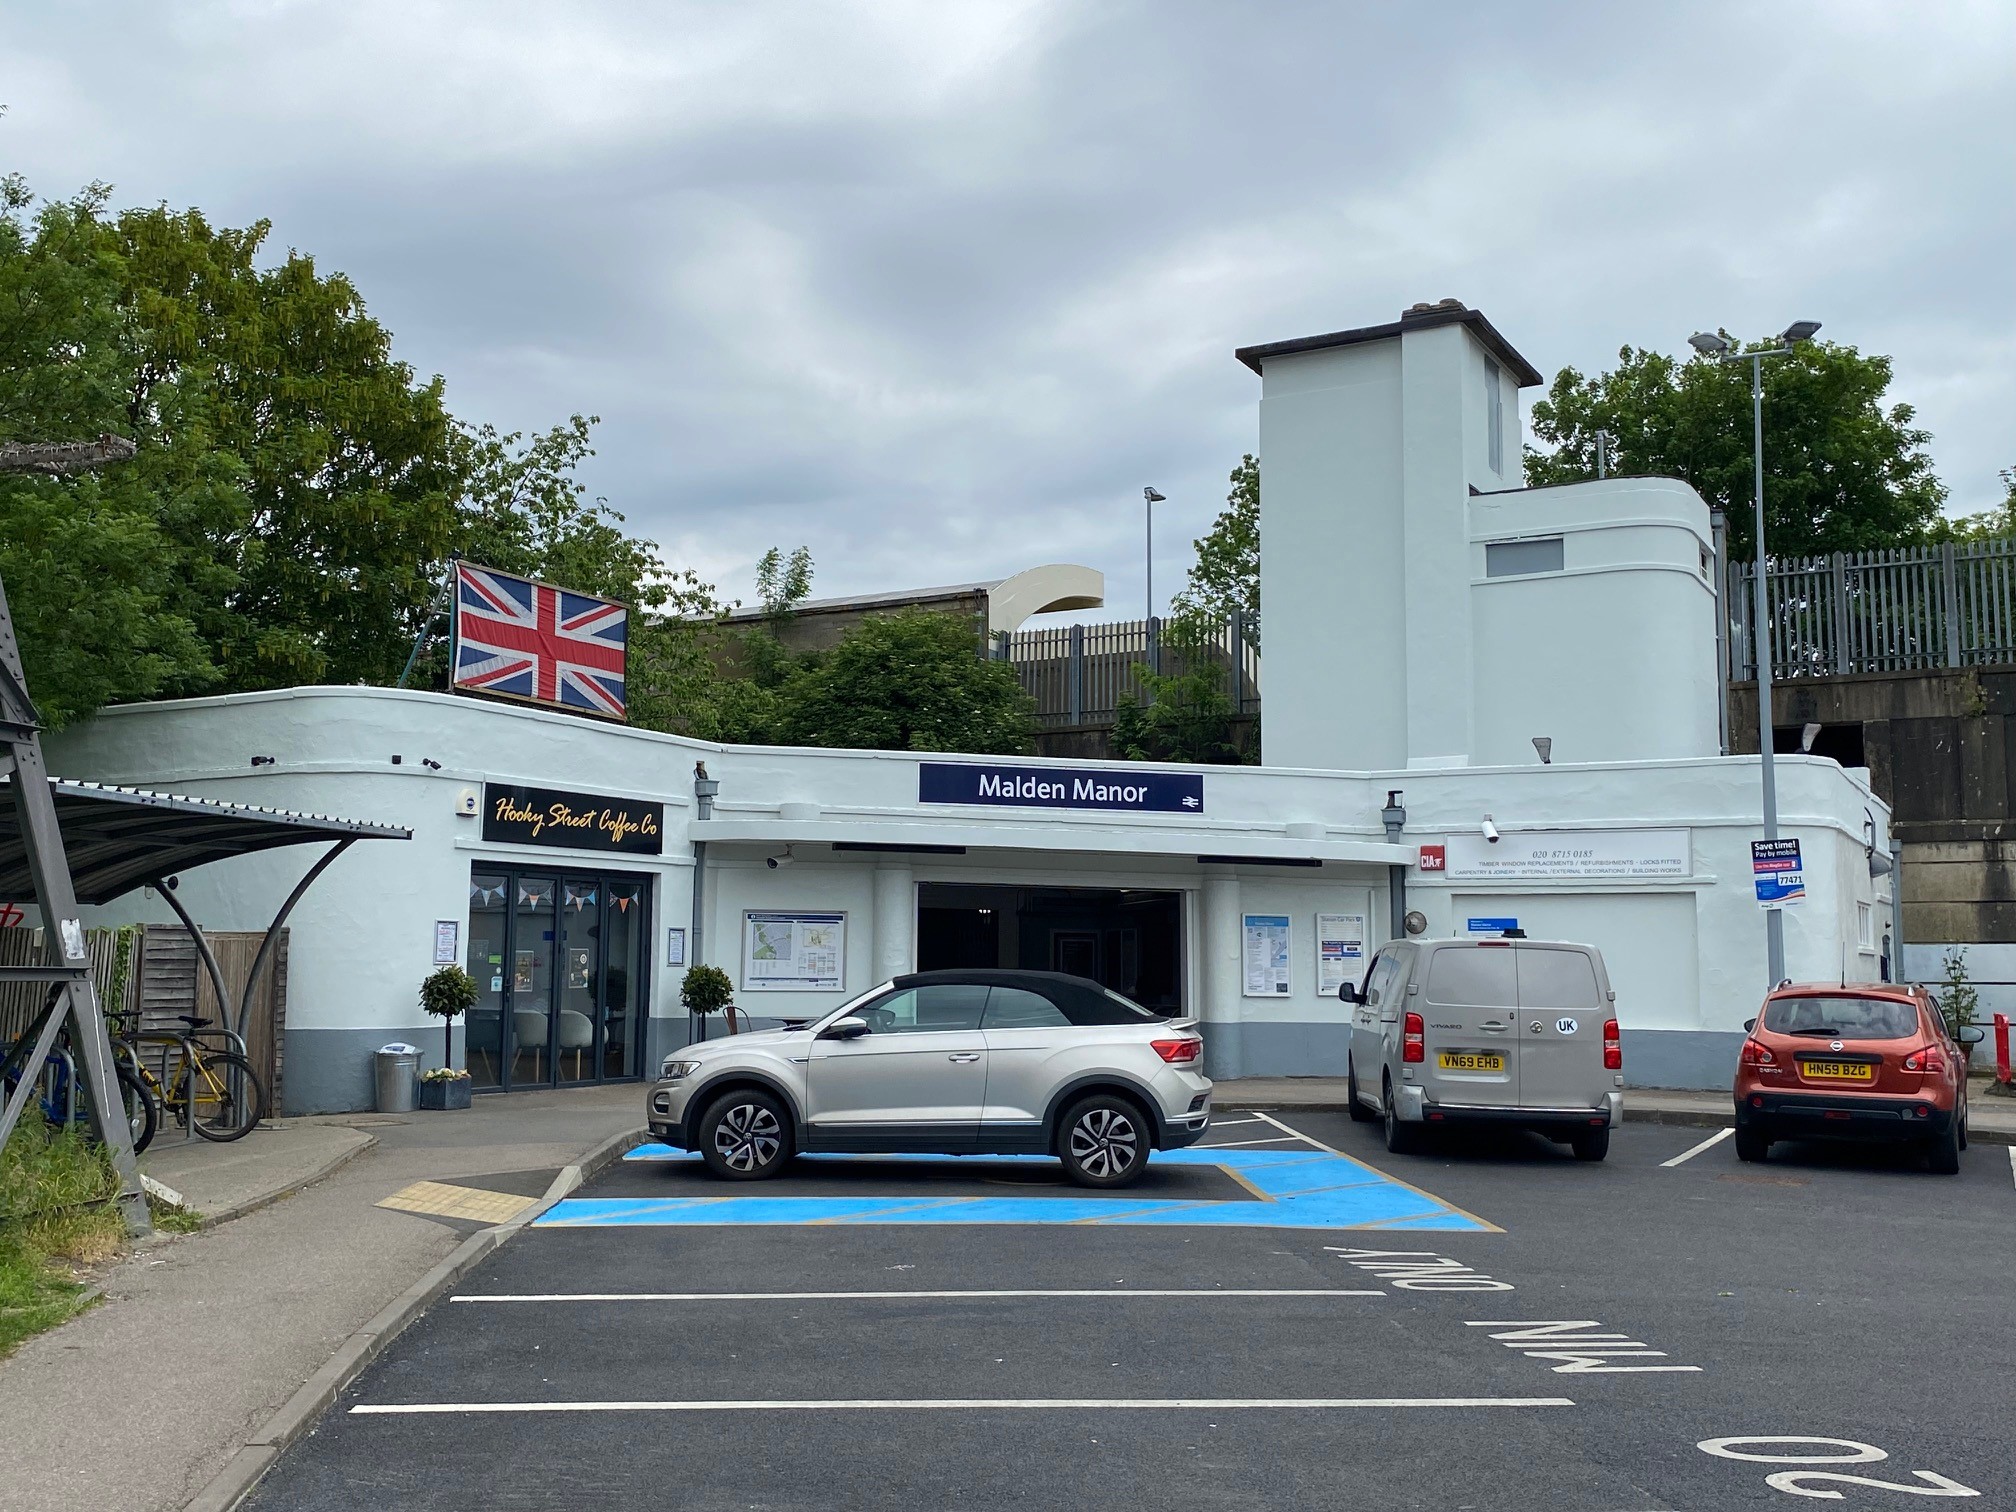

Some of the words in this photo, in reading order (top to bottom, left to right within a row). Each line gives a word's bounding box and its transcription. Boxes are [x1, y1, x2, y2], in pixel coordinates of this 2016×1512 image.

[978, 773, 1065, 800] Malden
[1072, 778, 1148, 803] Manor
[496, 797, 545, 837] Hooky
[548, 803, 597, 828] Street
[598, 809, 639, 843] Coffee
[641, 813, 657, 835] Co
[1774, 840, 1796, 849] time!
[1421, 854, 1435, 868] CIA
[1532, 850, 1547, 859] 020
[1551, 850, 1571, 858] 8715
[1573, 849, 1593, 858] 0185
[1780, 876, 1802, 884] 77471
[1558, 1020, 1575, 1032] UK
[1444, 1055, 1474, 1068] VN69
[1477, 1057, 1499, 1069] EHB
[1808, 1063, 1839, 1075] HN59
[1843, 1064, 1866, 1076] BZG
[1323, 1245, 1515, 1292] ONLY
[1464, 1320, 1703, 1373] MIN
[1697, 1435, 1981, 1500] 20
